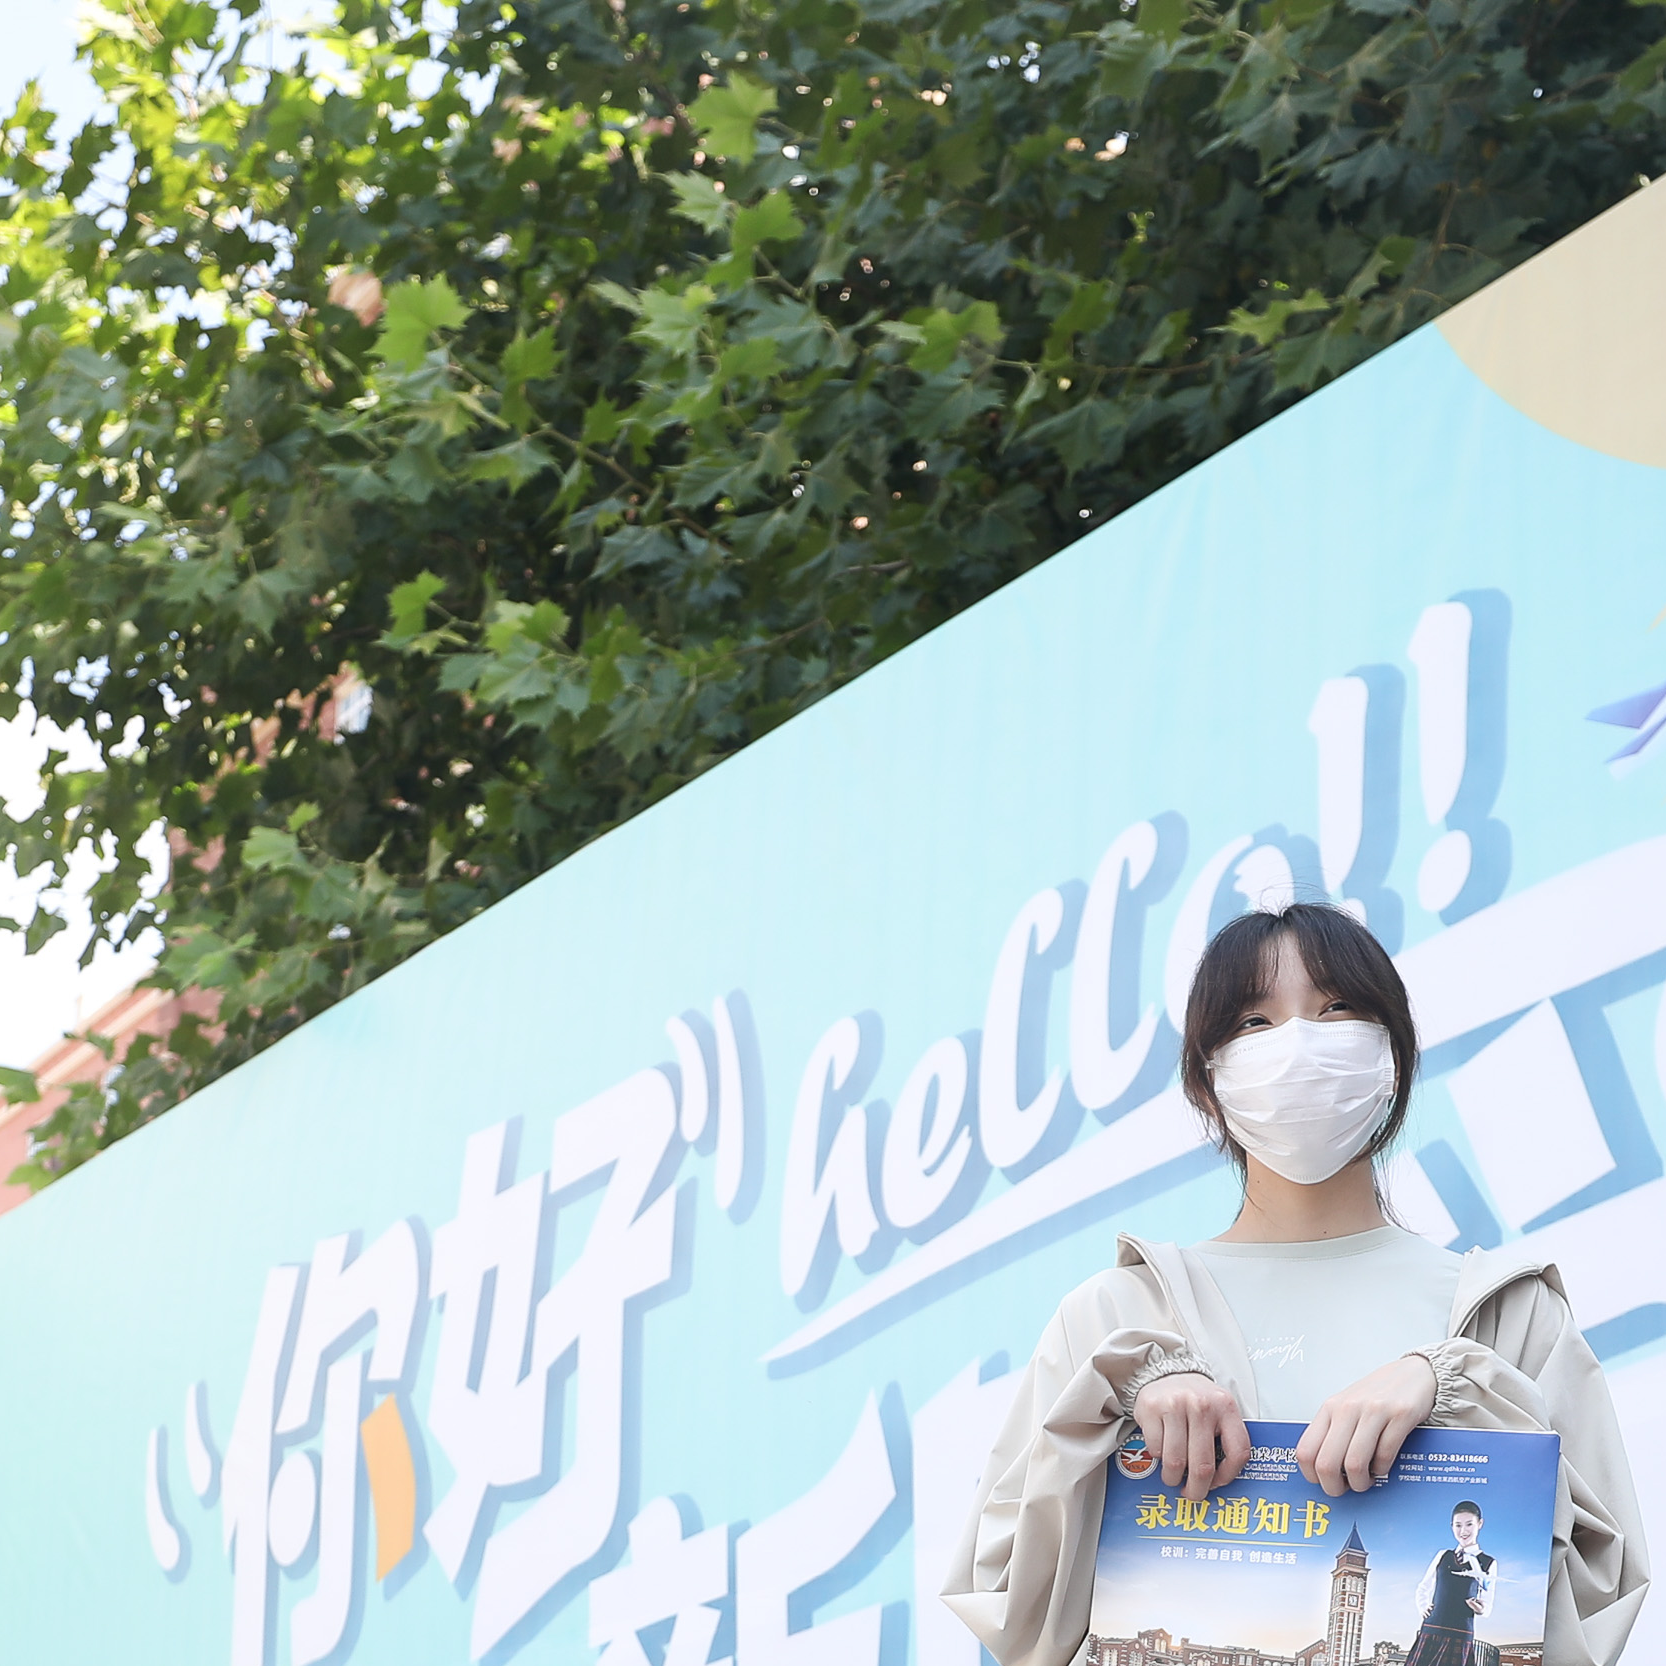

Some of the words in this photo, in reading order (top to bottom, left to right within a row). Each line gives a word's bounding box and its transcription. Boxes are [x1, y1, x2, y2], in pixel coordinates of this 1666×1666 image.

[1428, 1453, 1489, 1463] 0532-83418666
[1135, 1493, 1332, 1539] 录取通知书
